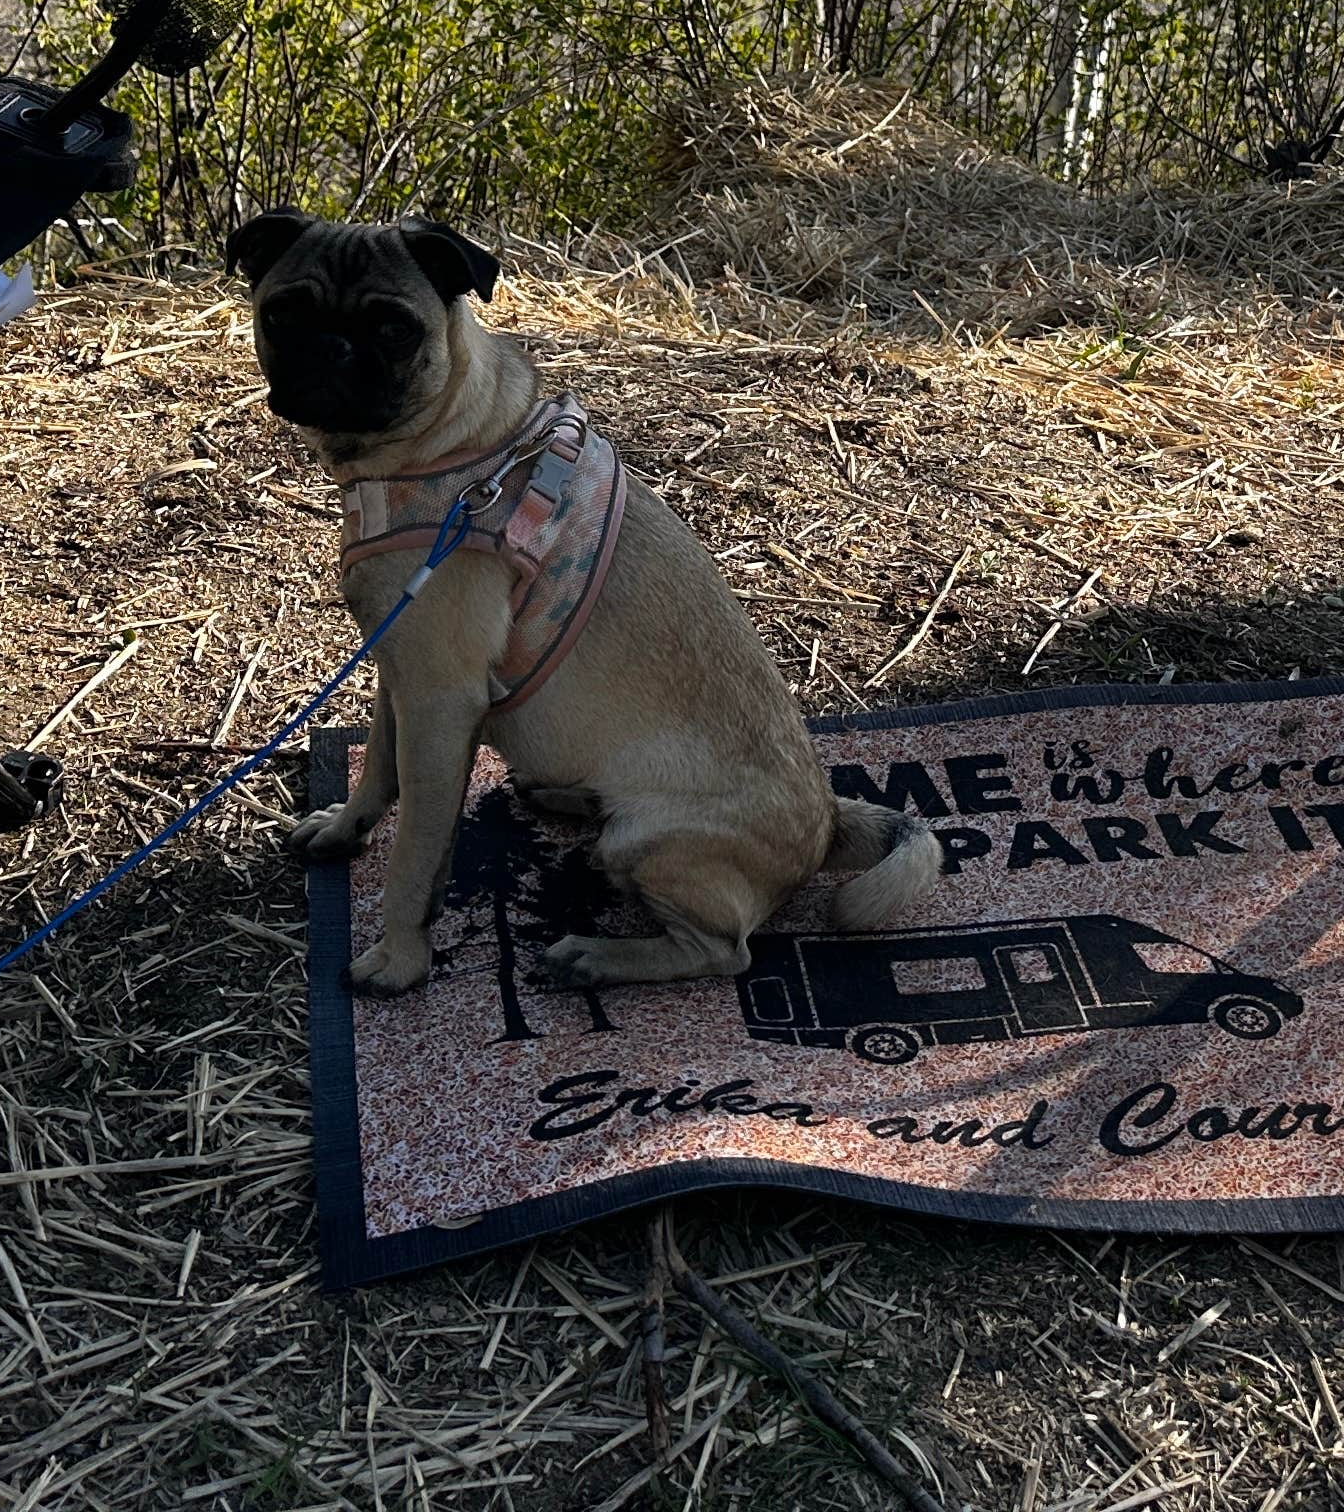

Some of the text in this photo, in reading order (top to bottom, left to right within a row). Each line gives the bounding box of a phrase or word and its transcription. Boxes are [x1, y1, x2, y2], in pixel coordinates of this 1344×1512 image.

[829, 753, 1023, 819] ME
[1043, 740, 1101, 771] is
[929, 810, 1249, 875] PARK
[528, 1069, 829, 1142] Erika
[866, 1099, 1055, 1150] and
